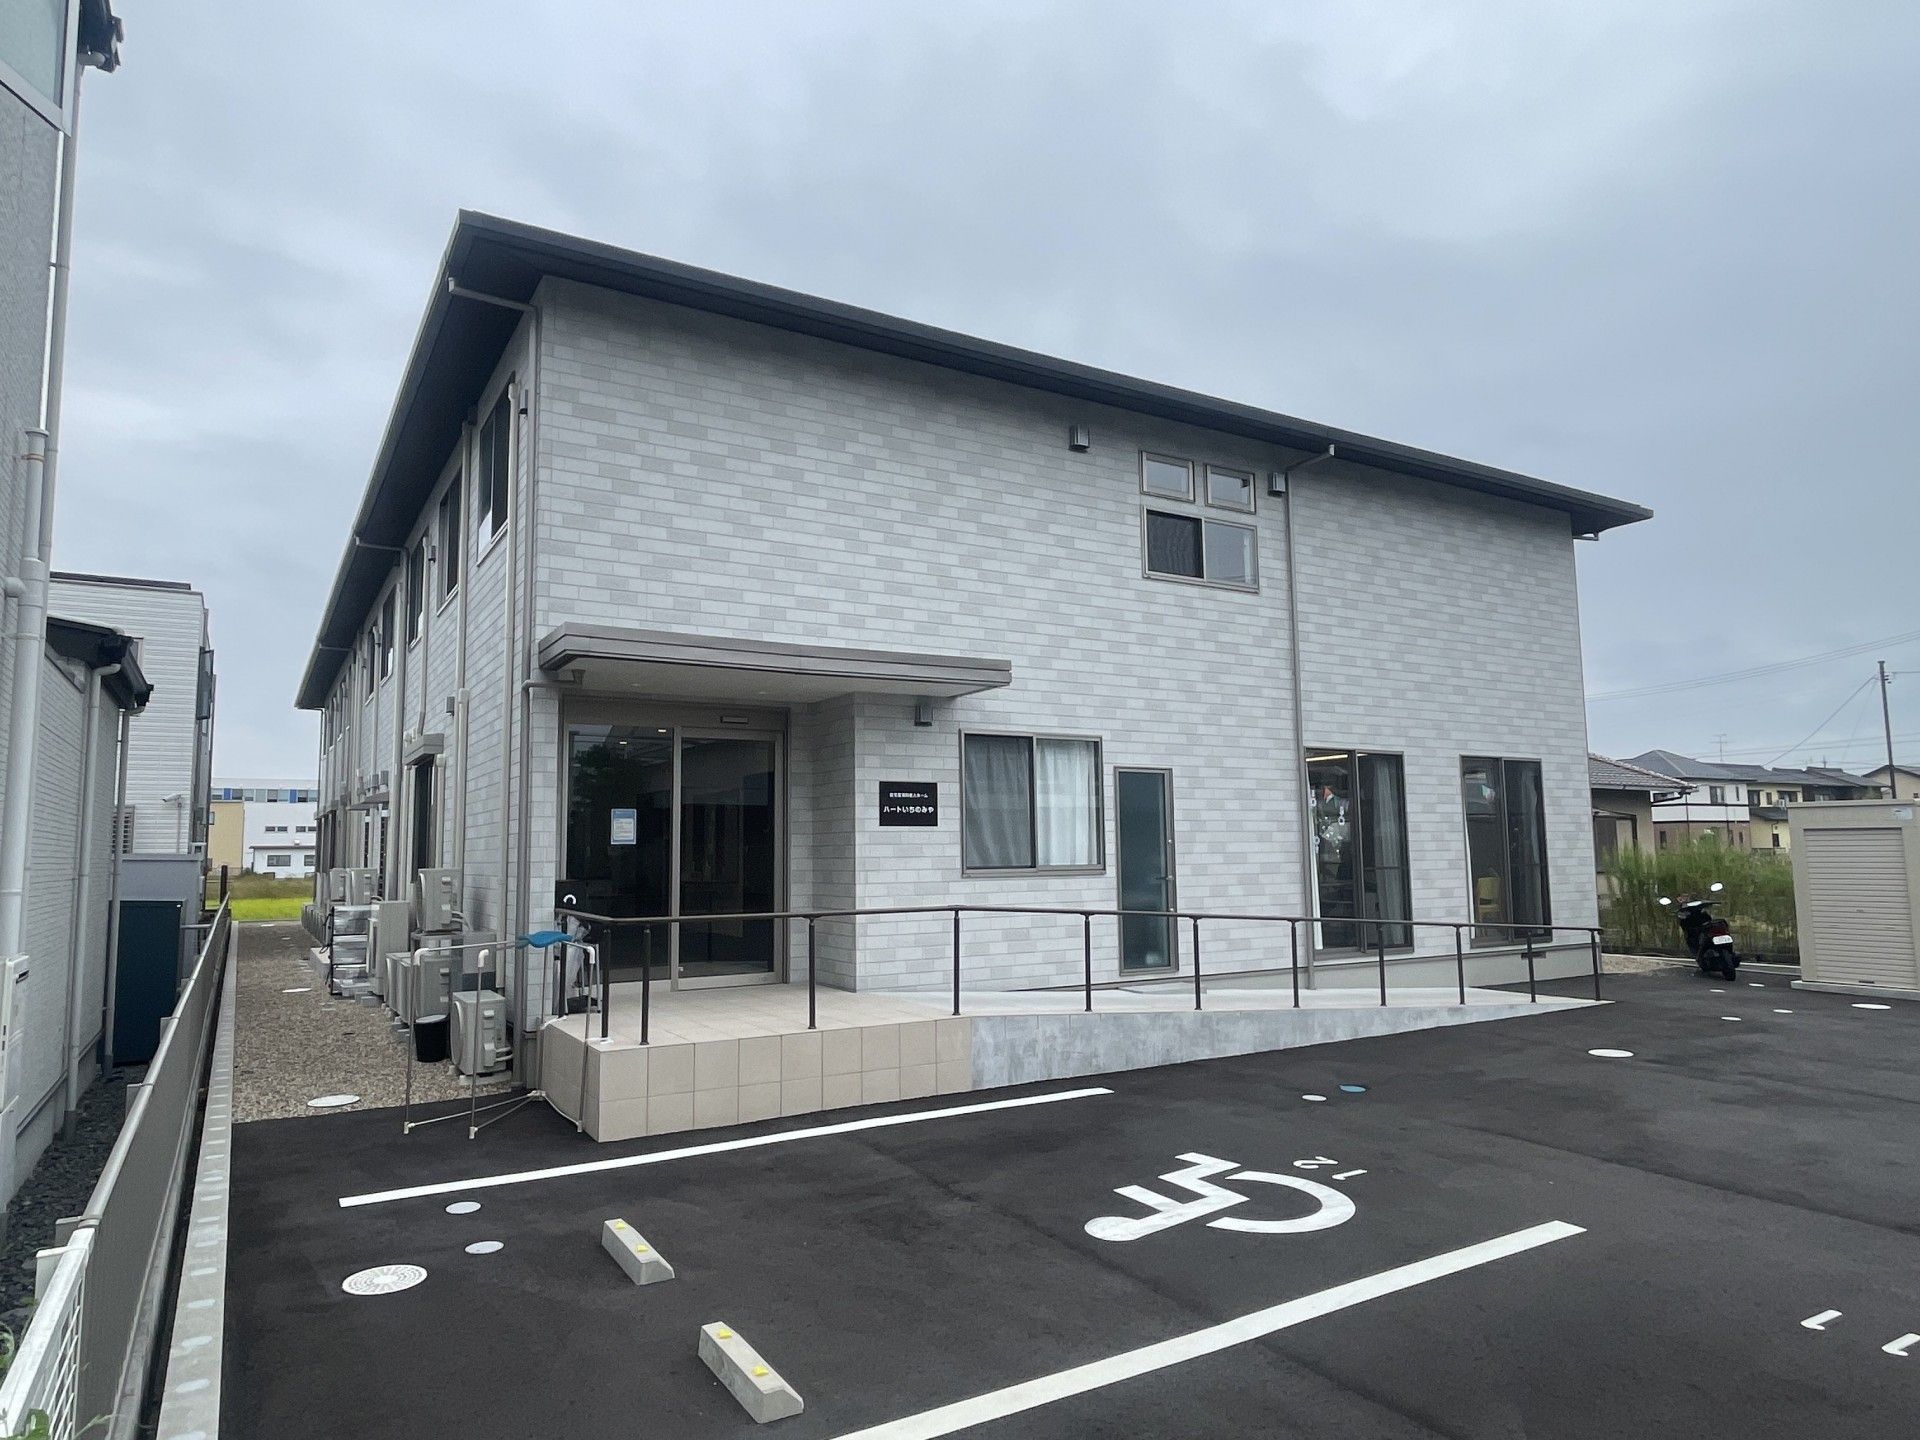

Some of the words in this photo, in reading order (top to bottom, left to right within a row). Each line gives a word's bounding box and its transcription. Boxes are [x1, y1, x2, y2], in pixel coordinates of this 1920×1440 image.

[883, 805, 935, 814] ハートいちのみや
